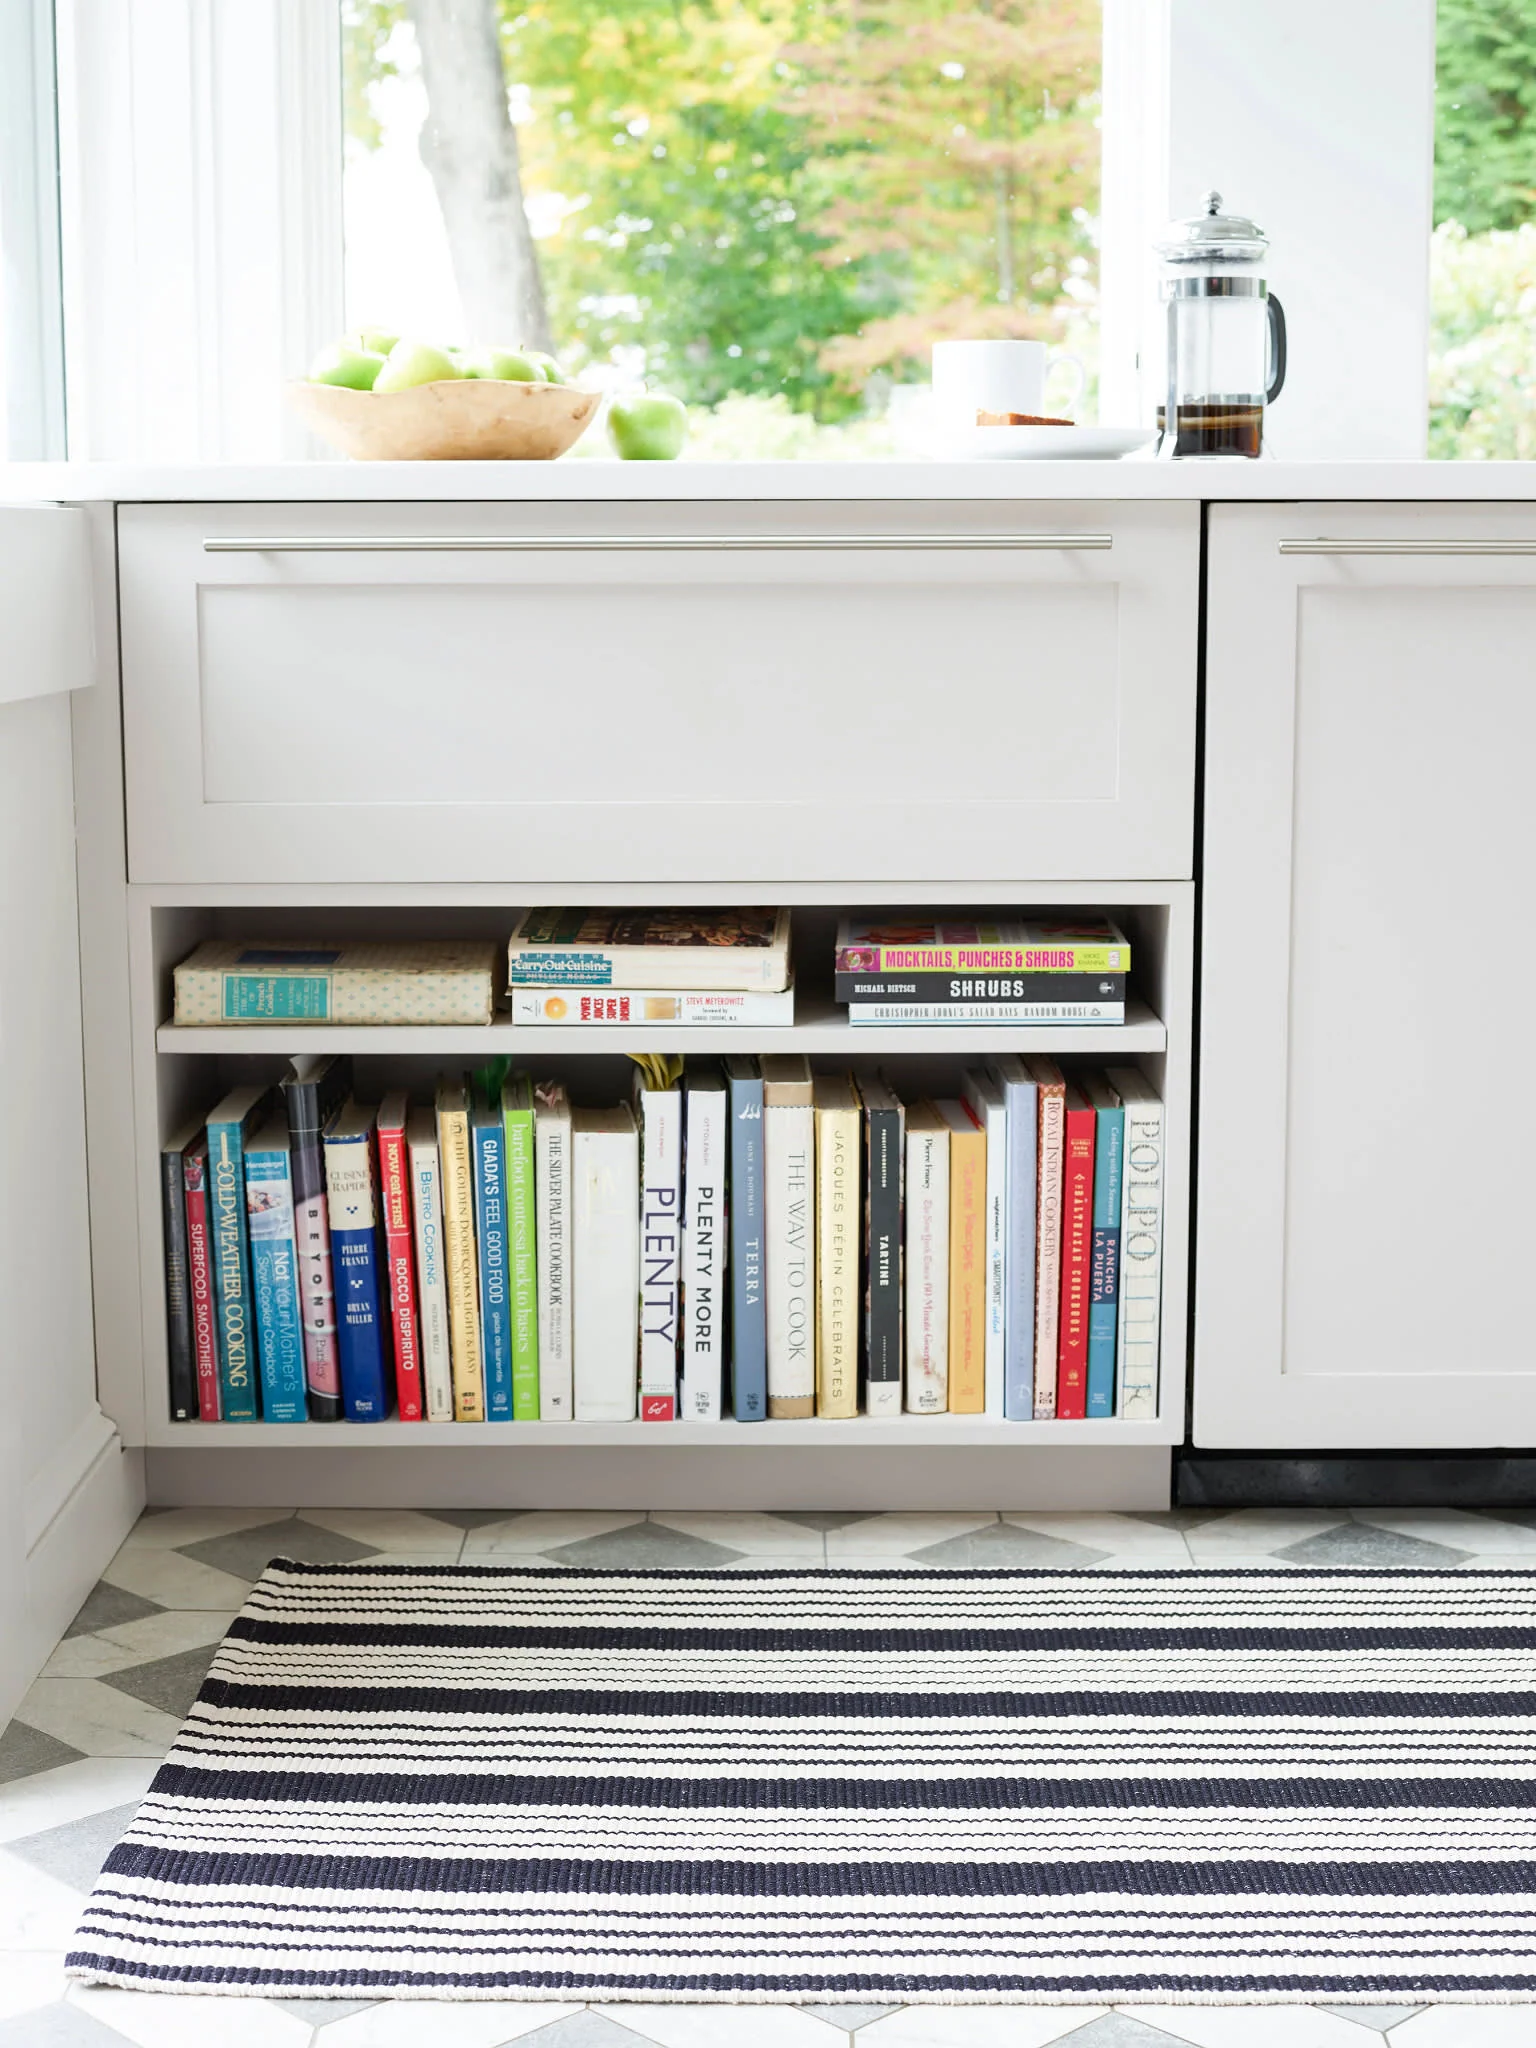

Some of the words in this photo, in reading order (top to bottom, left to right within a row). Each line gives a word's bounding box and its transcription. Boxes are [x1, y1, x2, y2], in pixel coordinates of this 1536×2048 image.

[885, 950, 956, 969] MOCKTAILS,
[958, 950, 1013, 968] PUNCHES
[1015, 950, 1023, 968] &
[1025, 950, 1074, 968] SHRUBS
[256, 983, 264, 1011] French
[265, 979, 276, 1016] Cooking
[580, 996, 591, 1021] POWER
[686, 997, 703, 1006] STEVE
[854, 984, 886, 993] MICHAEL
[887, 984, 916, 993] DIETSCH
[950, 979, 1025, 997] SHRUBS
[606, 998, 616, 1020] SUPER
[1047, 1101, 1061, 1142] ROYAL
[1108, 1127, 1119, 1156] Cooking
[511, 1123, 529, 1185] barefoot
[549, 1134, 562, 1157] THE
[924, 1138, 933, 1162] Pierre
[1109, 1158, 1118, 1174] with
[483, 1139, 499, 1195] GIADA'S
[549, 1159, 562, 1195] SILVER
[788, 1149, 806, 1192] THE
[833, 1130, 844, 1213] JACQUES
[1046, 1146, 1060, 1193] INDIAN
[1109, 1175, 1118, 1187] the
[486, 1199, 501, 1228] FEEL
[513, 1188, 527, 1250] contessa
[549, 1198, 562, 1240] PALATE
[696, 1187, 713, 1277] PLENTY
[785, 1199, 806, 1251] WAY
[1044, 1196, 1059, 1259] COOKERY
[341, 1244, 368, 1255] PIERRE
[486, 1231, 502, 1267] GOOD
[833, 1223, 846, 1275] PÉPIN
[1096, 1231, 1104, 1248] LA
[191, 1223, 207, 1299] SUPERFOOD
[257, 1256, 269, 1284] Slow
[274, 1251, 291, 1282] Not
[308, 1209, 325, 1329] BEYOND
[395, 1257, 410, 1303] ROCCO
[514, 1253, 532, 1287] back
[549, 1242, 562, 1306] COOKBOOK
[643, 1187, 676, 1343] PLENTY
[745, 1237, 759, 1305] TERRA
[787, 1256, 806, 1288] TO
[879, 1235, 889, 1287] TARTINE
[1093, 1253, 1104, 1302] PUERTA
[1104, 1239, 1116, 1294] RANCHO
[259, 1286, 273, 1326] Cooker
[277, 1283, 292, 1320] Your
[488, 1269, 504, 1304] FOOD
[517, 1291, 529, 1305] to
[346, 1313, 373, 1325] MILLER
[347, 1302, 371, 1313] BRYAN
[696, 1287, 712, 1353] MORE
[196, 1304, 212, 1377] SMOOTHIES
[225, 1303, 248, 1388] COOKING
[399, 1307, 415, 1370] DISPIRITO
[517, 1308, 533, 1353] basics
[788, 1297, 807, 1361] COOK
[832, 1286, 843, 1398] CELEBRATES
[263, 1329, 277, 1388] Cookbook
[280, 1323, 300, 1392] Mother's
[315, 1339, 326, 1379] Parsley
